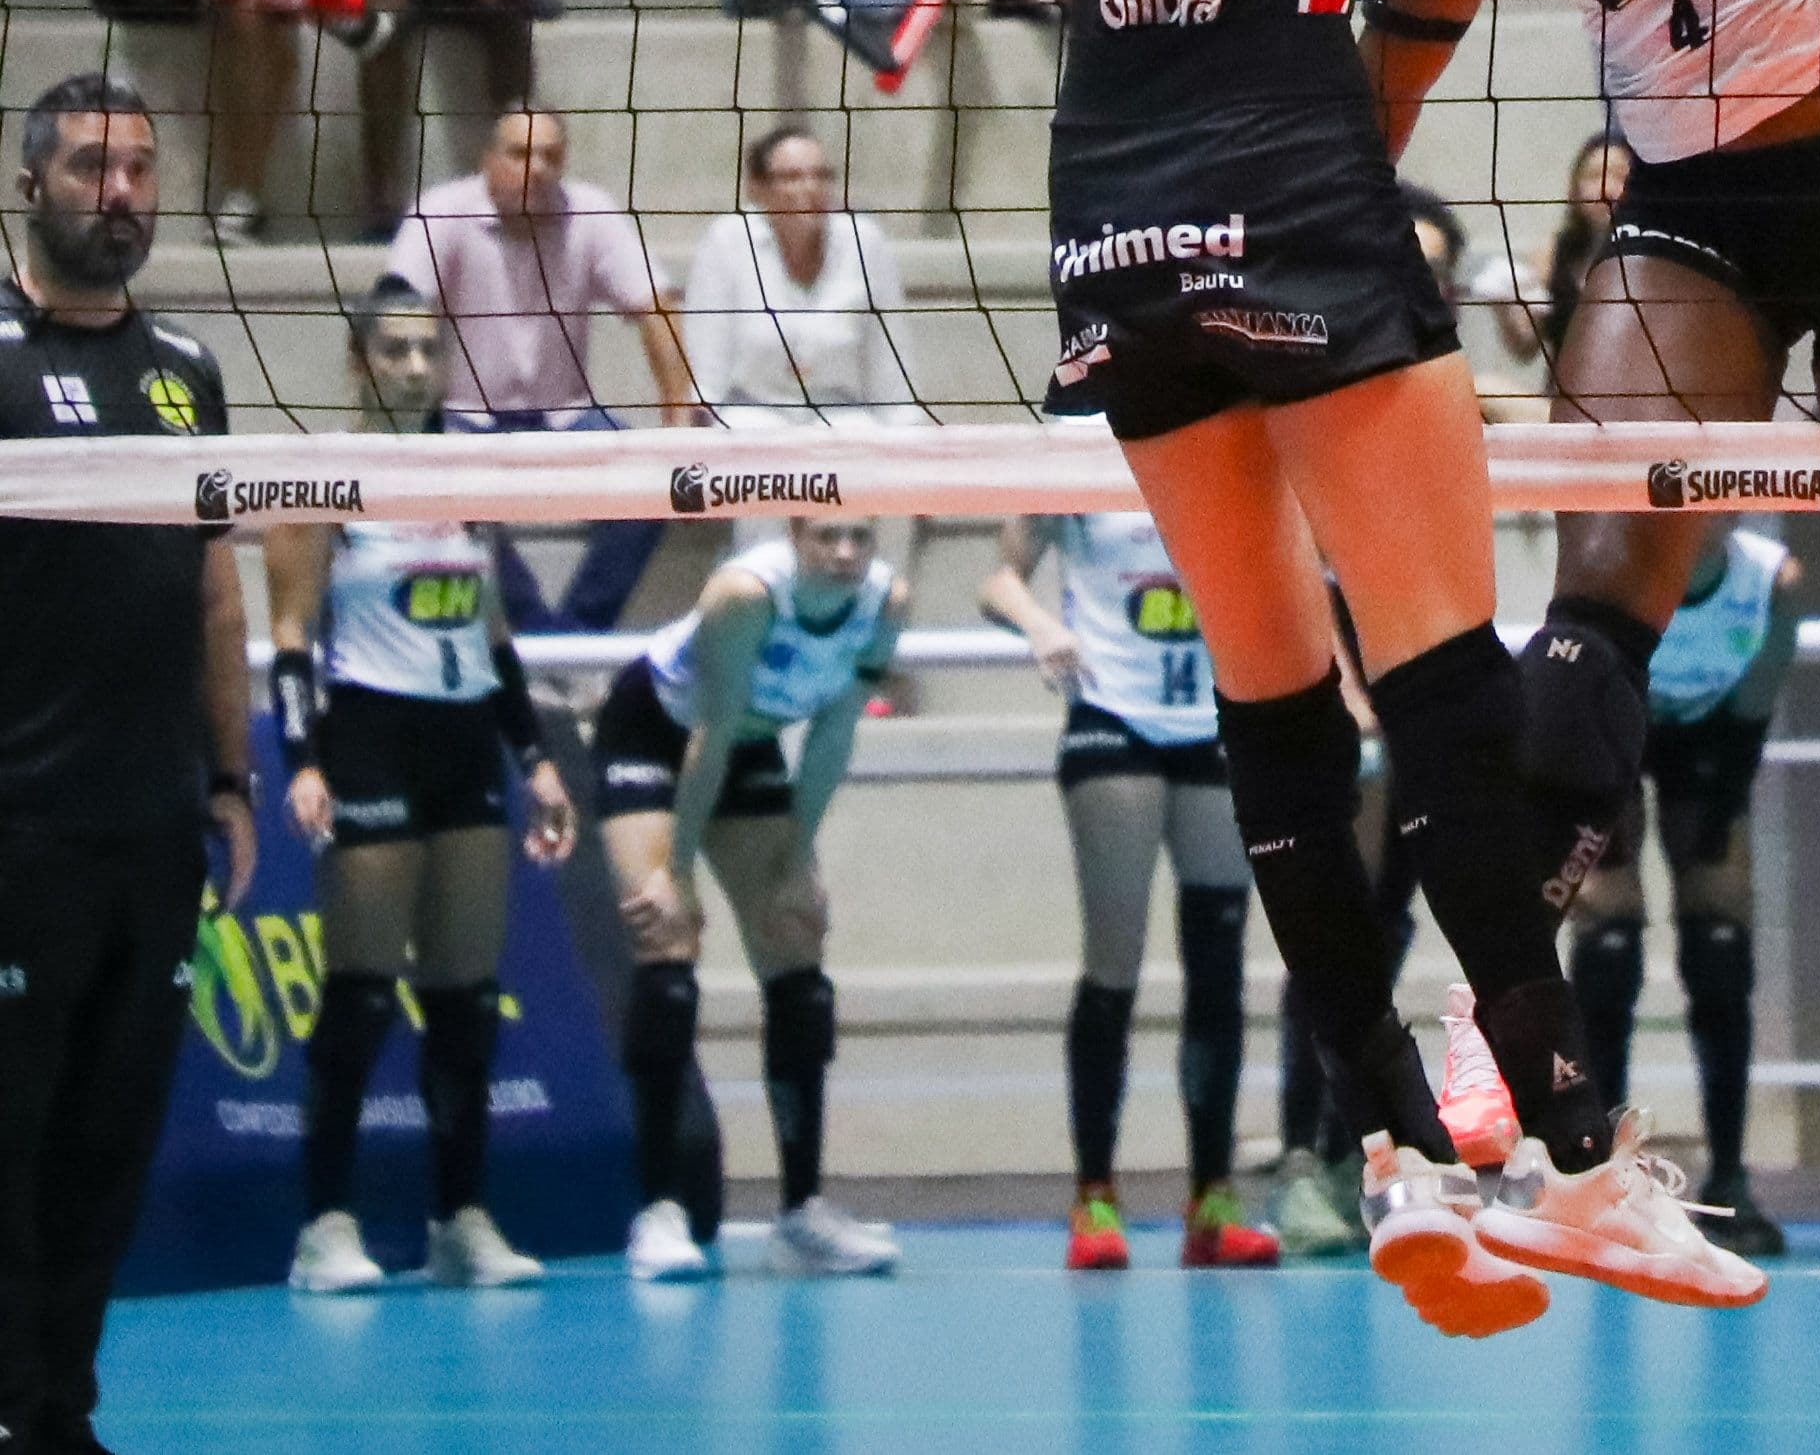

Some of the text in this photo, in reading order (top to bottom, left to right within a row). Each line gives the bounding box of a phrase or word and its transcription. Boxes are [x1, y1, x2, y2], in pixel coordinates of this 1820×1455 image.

[1178, 271, 1244, 293] Bauru
[234, 480, 364, 515] SUPERLIGA
[709, 473, 842, 507] SUPERLIGA
